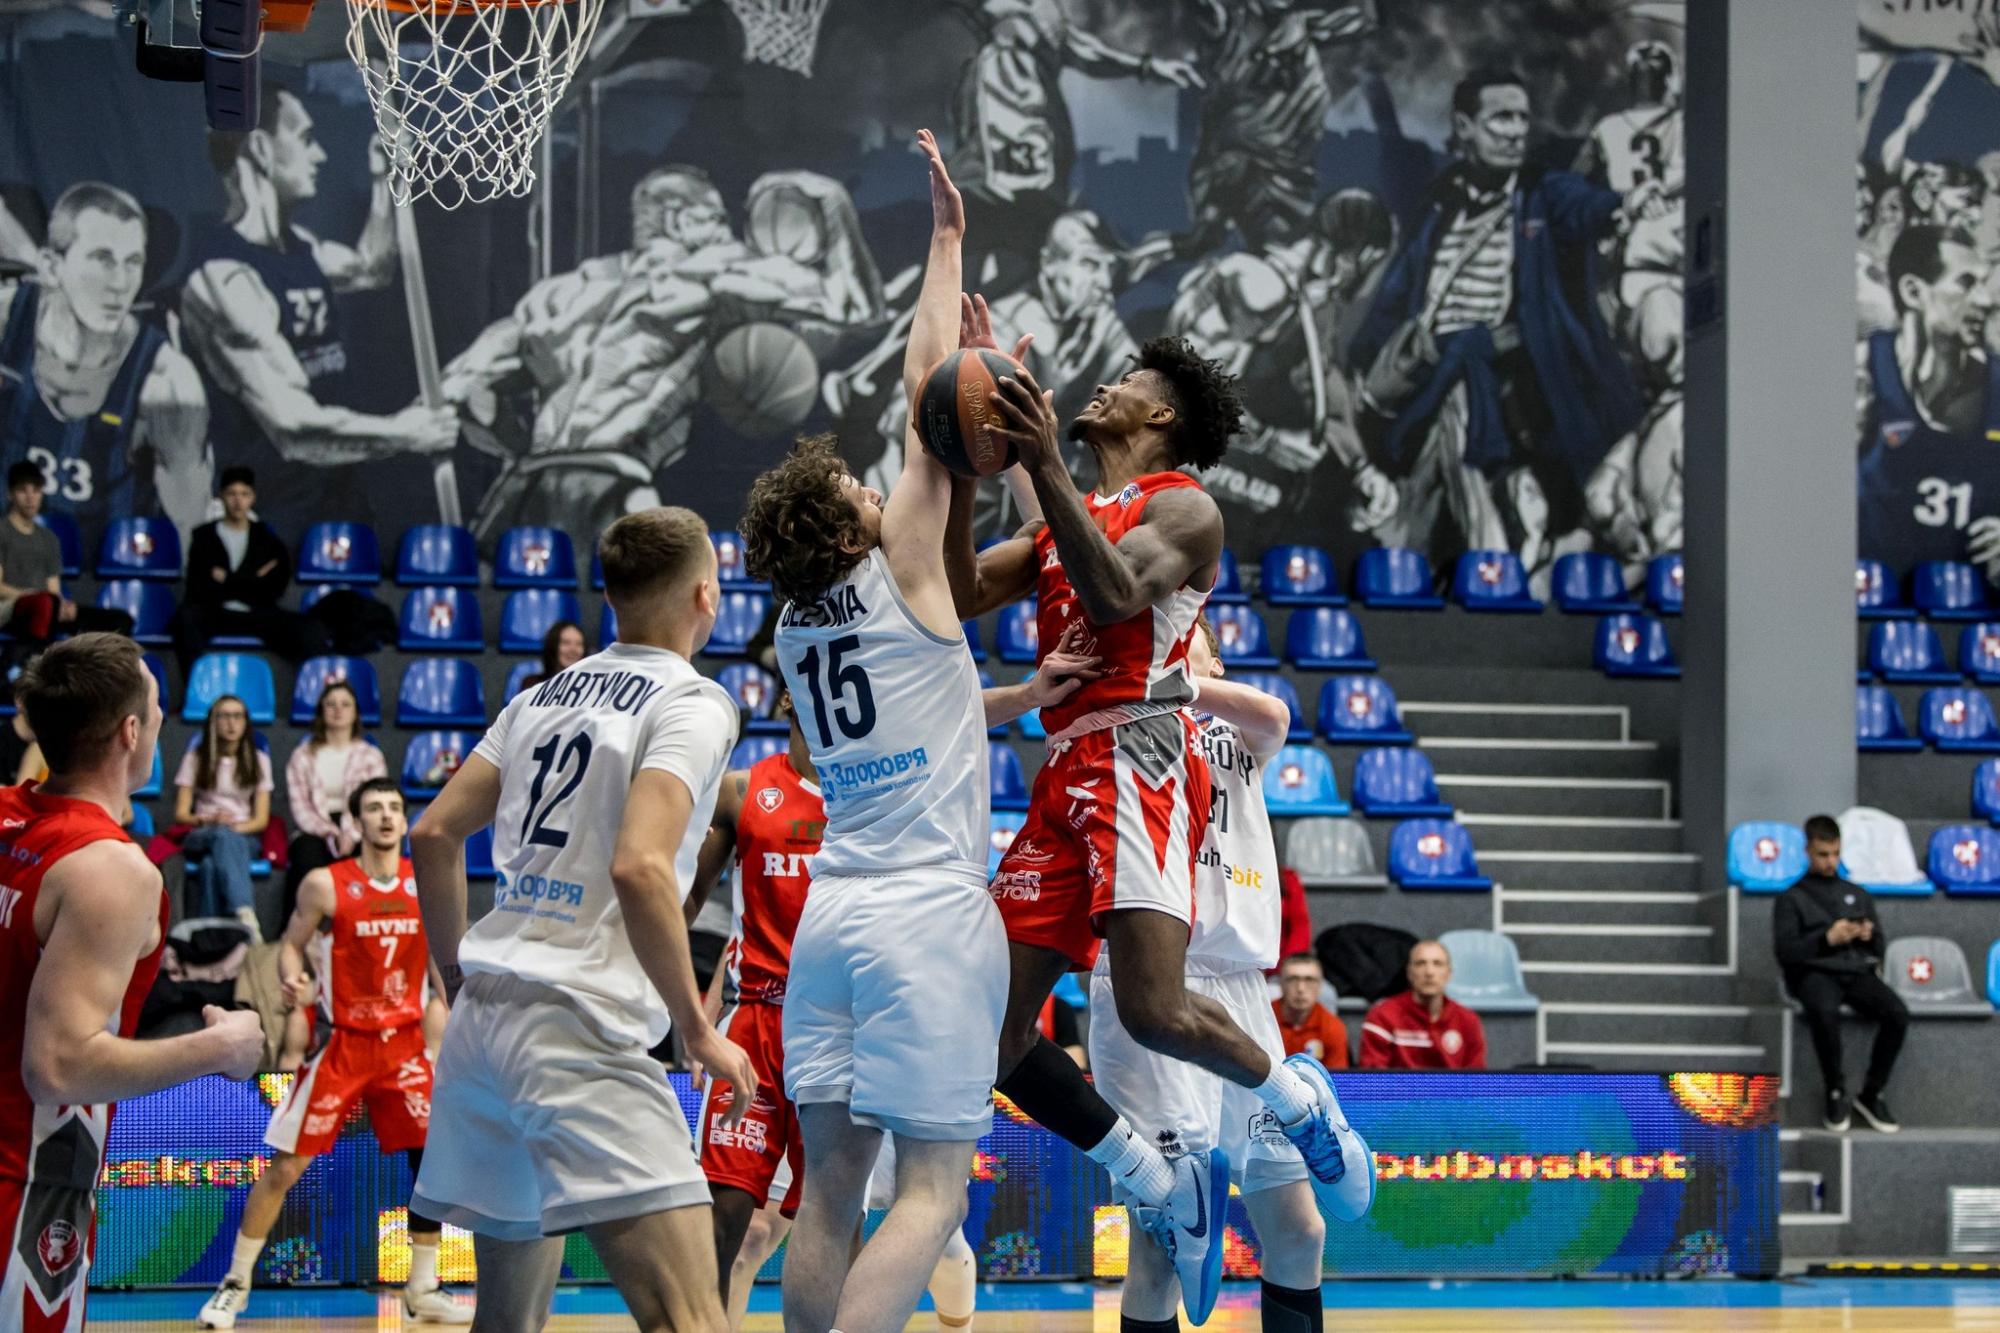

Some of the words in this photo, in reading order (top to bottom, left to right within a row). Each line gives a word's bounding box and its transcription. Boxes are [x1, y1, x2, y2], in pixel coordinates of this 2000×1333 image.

[27, 446, 93, 502] 33
[1913, 477, 1973, 530] 31
[529, 671, 664, 716] MARTYNOV
[796, 634, 876, 749] 15
[519, 731, 592, 848] 12
[356, 918, 419, 937] RIVNE
[380, 936, 399, 968] 7
